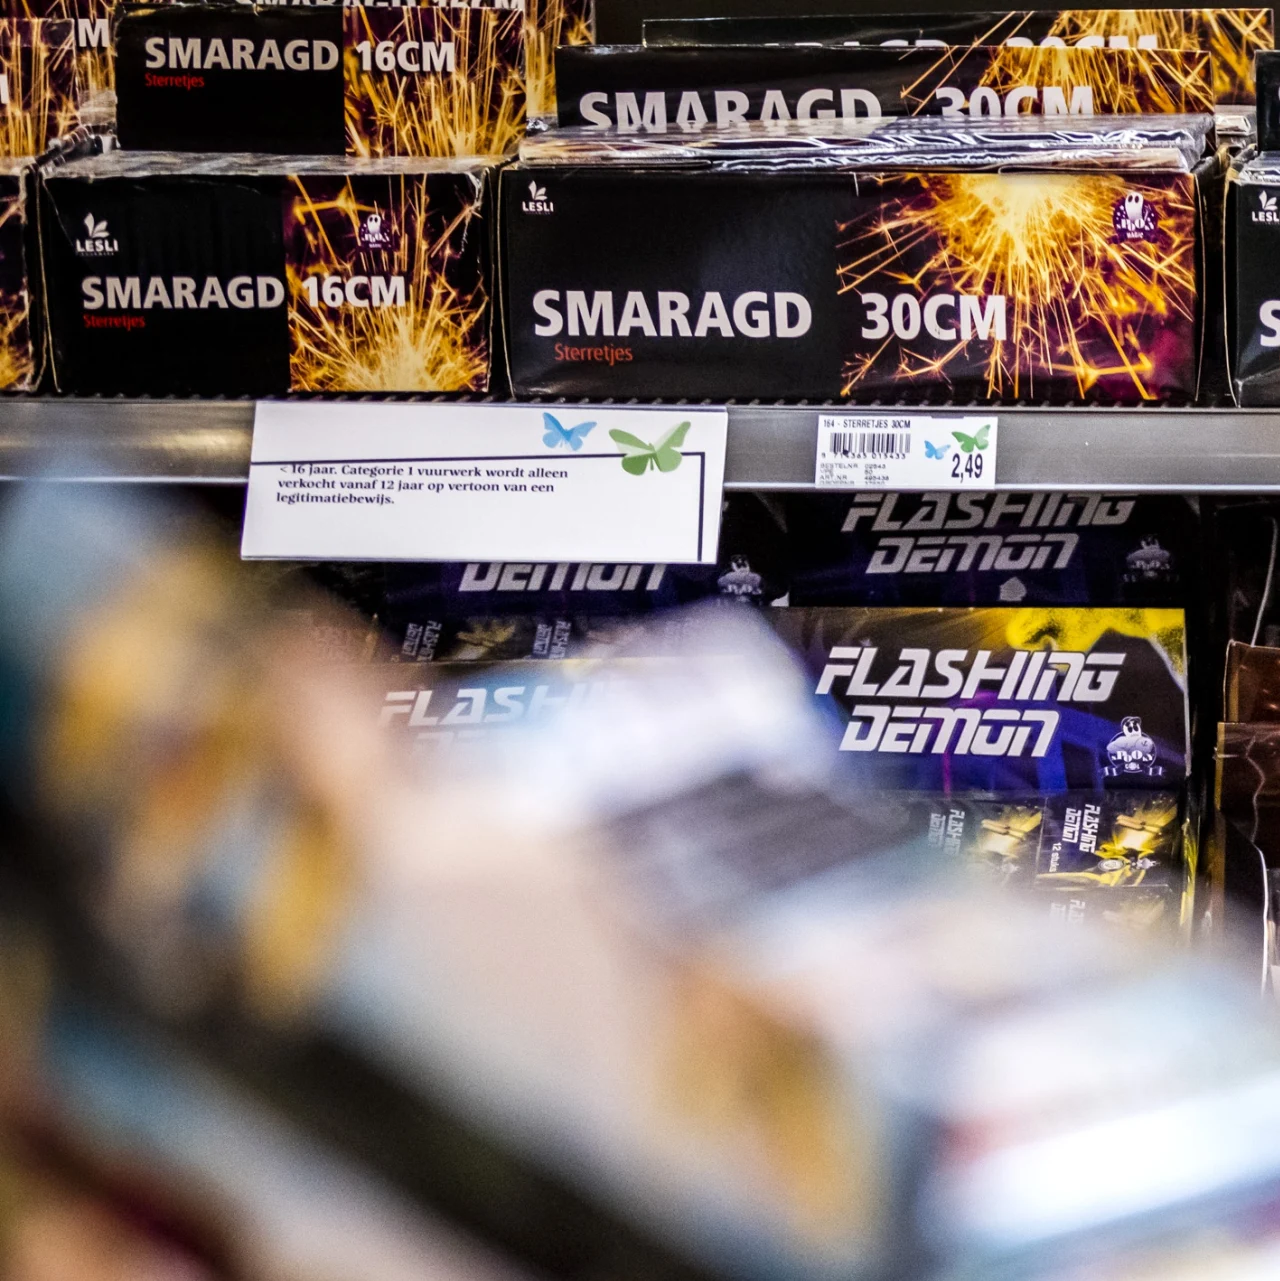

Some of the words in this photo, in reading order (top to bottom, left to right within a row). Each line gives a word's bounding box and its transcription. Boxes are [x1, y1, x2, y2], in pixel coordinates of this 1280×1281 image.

[145, 38, 339, 70] SMARAGD
[356, 41, 455, 72] 16CM
[144, 73, 205, 88] Sterretjes
[522, 201, 554, 213] LESLI
[76, 239, 119, 253] LESLI
[81, 276, 285, 309] SMARAGD
[303, 276, 406, 307] 16CM
[533, 289, 812, 339] SMARAGD
[861, 294, 1007, 341] 30CM
[555, 342, 633, 364] Sterretjes
[844, 420, 888, 429] STERRETJES
[892, 420, 911, 429] 30CM
[291, 465, 306, 474] 16
[308, 465, 337, 477] jaar.
[342, 465, 404, 477] Categorie
[417, 466, 481, 478] vuurwerk
[486, 467, 524, 478] wordt
[528, 468, 568, 478] alleen
[951, 453, 983, 484] 2,49
[276, 492, 394, 506] legitimatiebewijs.
[279, 479, 335, 490] verkocht
[340, 480, 377, 490] vanaf
[381, 481, 394, 490] 12
[398, 480, 424, 493] jaar
[428, 484, 444, 494] op
[448, 482, 499, 492] vertoon
[504, 483, 527, 493] van
[531, 483, 554, 493] een
[841, 494, 1138, 533] FLASHING
[866, 533, 1079, 575] DEMON
[815, 646, 1127, 703] FLASHING
[838, 706, 1061, 759] DEMON
